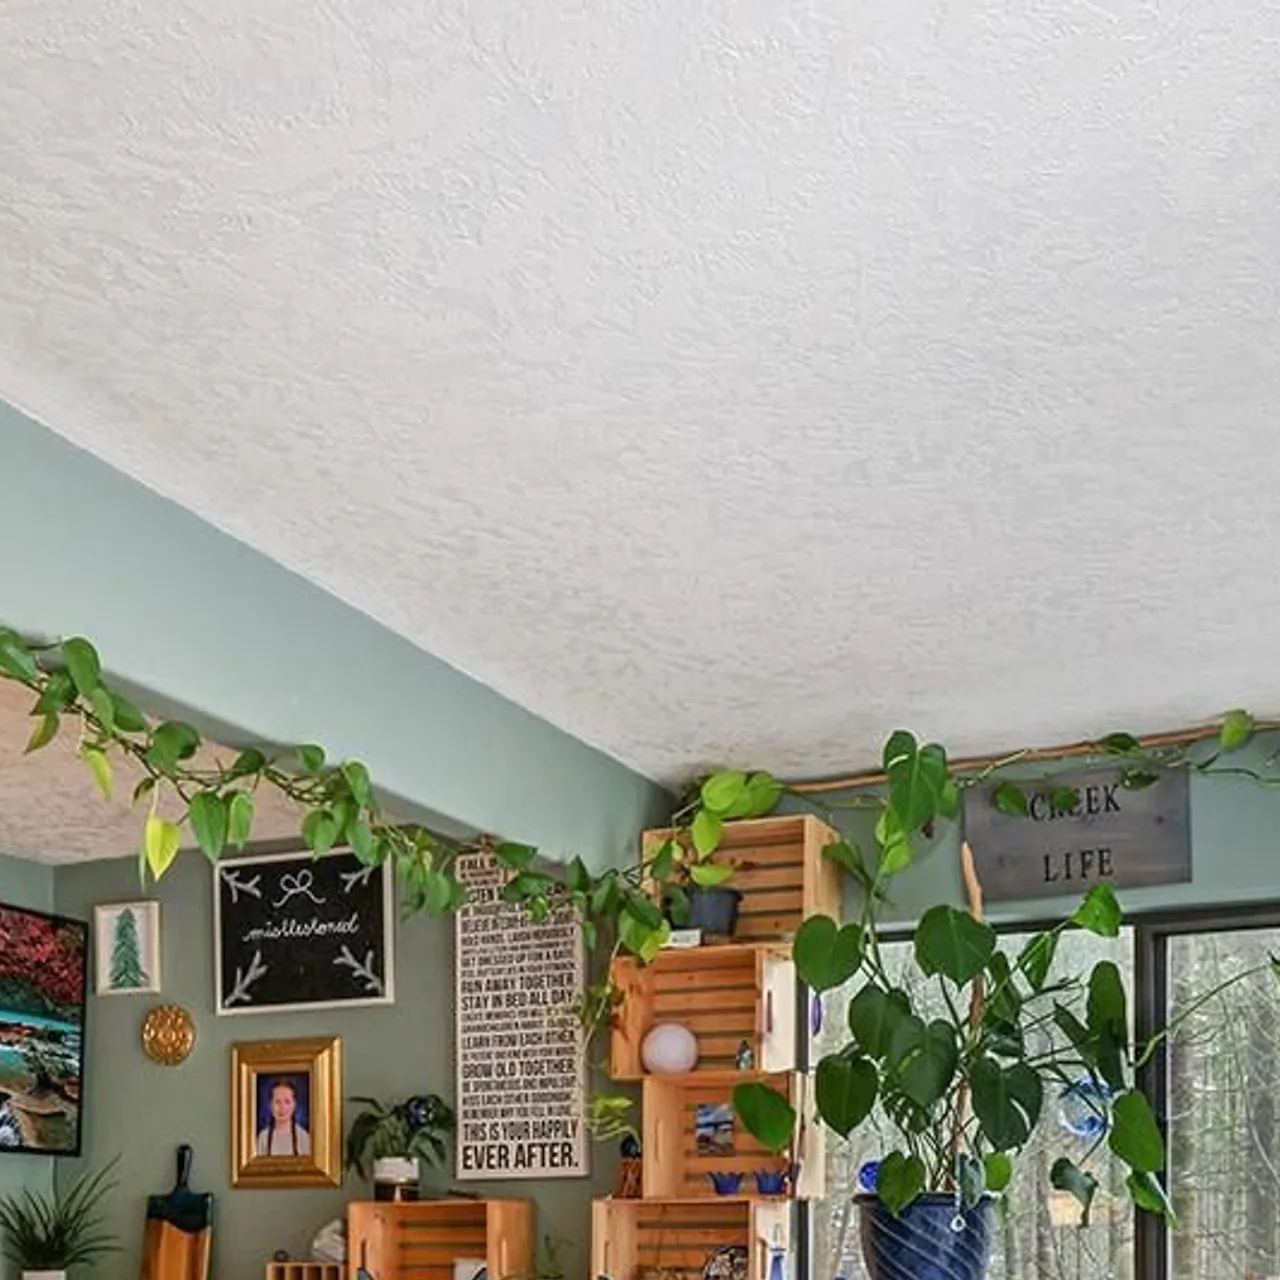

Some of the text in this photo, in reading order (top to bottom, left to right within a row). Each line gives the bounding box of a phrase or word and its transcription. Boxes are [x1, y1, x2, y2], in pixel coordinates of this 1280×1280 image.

[1043, 846, 1114, 882] LIFE
[462, 995, 490, 1011] STAY
[492, 994, 502, 1008] IN
[505, 991, 527, 1008] BED
[529, 990, 548, 1006] ALL
[462, 1063, 493, 1079] GROW
[496, 1061, 517, 1078] OLD
[463, 1118, 579, 1142] THIS IS YOUR HAPPILY
[462, 1141, 579, 1171] EVER AFTER.
